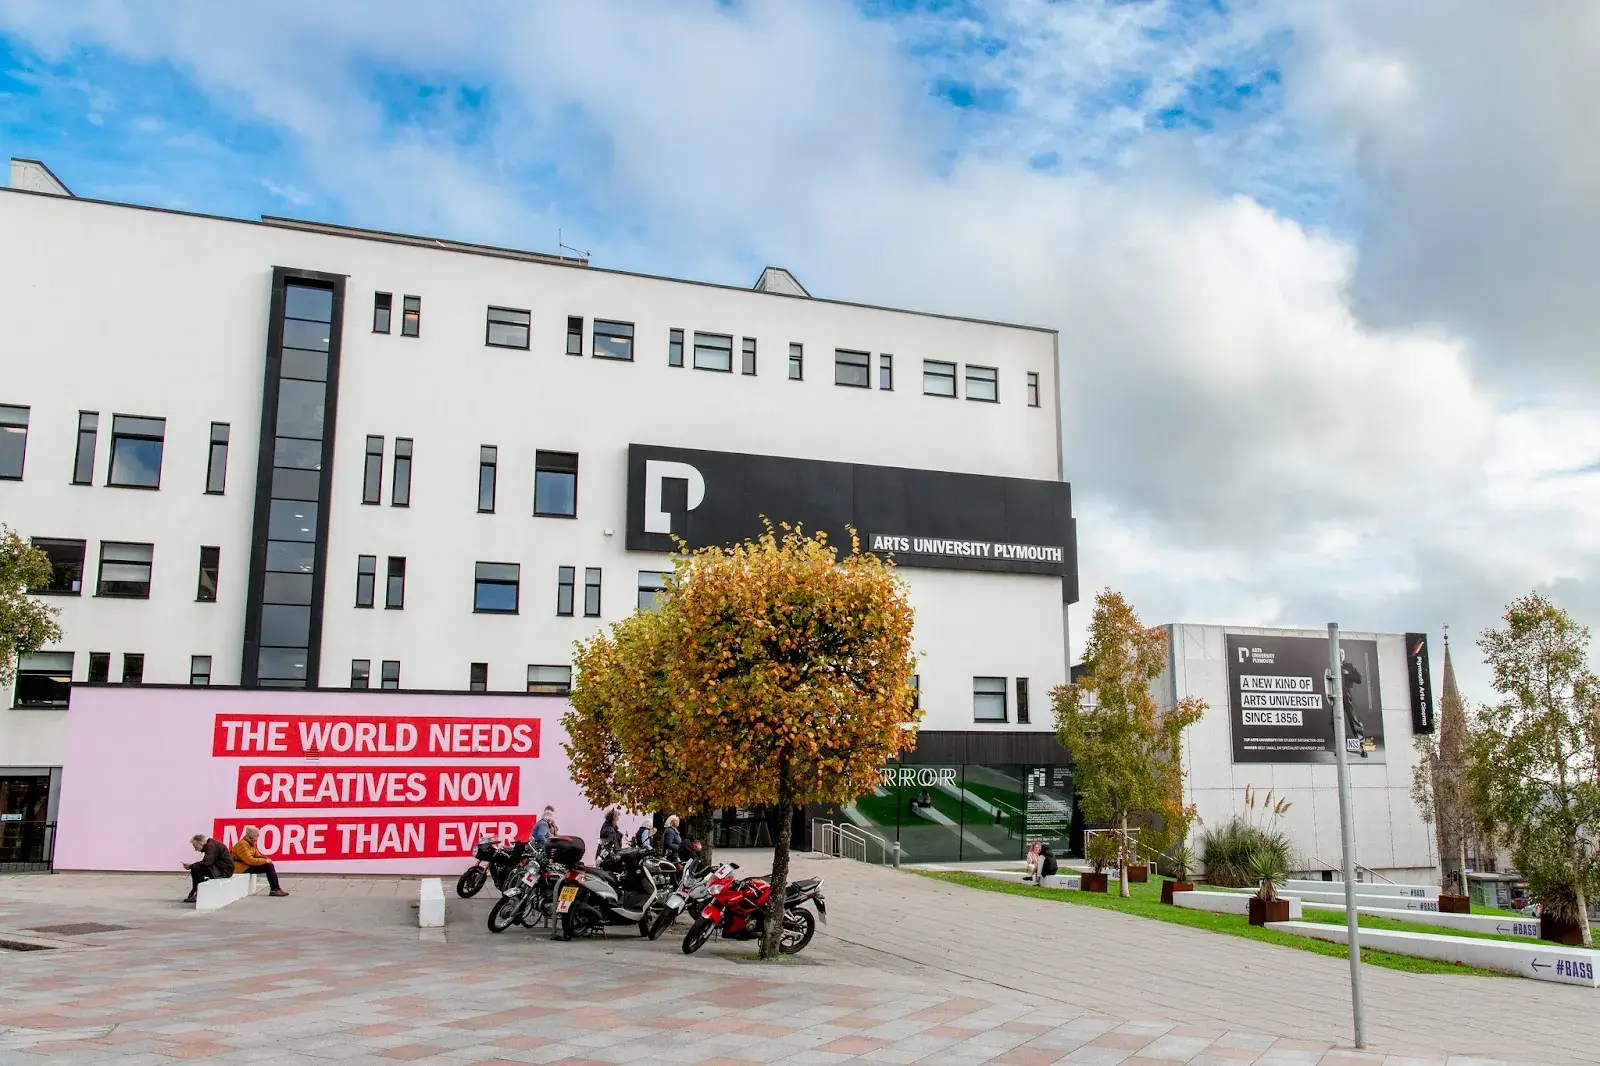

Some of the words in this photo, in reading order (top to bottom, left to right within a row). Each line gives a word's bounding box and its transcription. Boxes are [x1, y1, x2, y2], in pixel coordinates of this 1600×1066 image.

[873, 535, 910, 551] ARTS
[913, 538, 990, 557] UNIVERSITY
[993, 543, 1062, 562] PLYMOUTH
[1416, 656, 1424, 686] Plymouth
[1242, 677, 1249, 688] A
[1251, 677, 1273, 689] NEW
[1275, 678, 1297, 689] KIND
[1299, 679, 1311, 690] OF
[1243, 695, 1267, 706] ARTS
[1269, 695, 1320, 707] UNIVERSITY
[1245, 712, 1273, 723] SINCE
[1275, 712, 1301, 724] 1856.
[221, 720, 290, 751] THE
[298, 721, 418, 752] WORLD
[429, 723, 533, 753] NEEDS
[1348, 739, 1360, 749] NSS
[878, 767, 957, 787] RROR
[246, 772, 427, 803] CREATIVES
[438, 772, 514, 802] NOW
[336, 822, 426, 854] THAN
[1410, 888, 1425, 898] #BAS9
[1420, 902, 1437, 912] #BAS9
[1513, 923, 1537, 936] #BAS9
[1556, 959, 1593, 980] #BAS9
